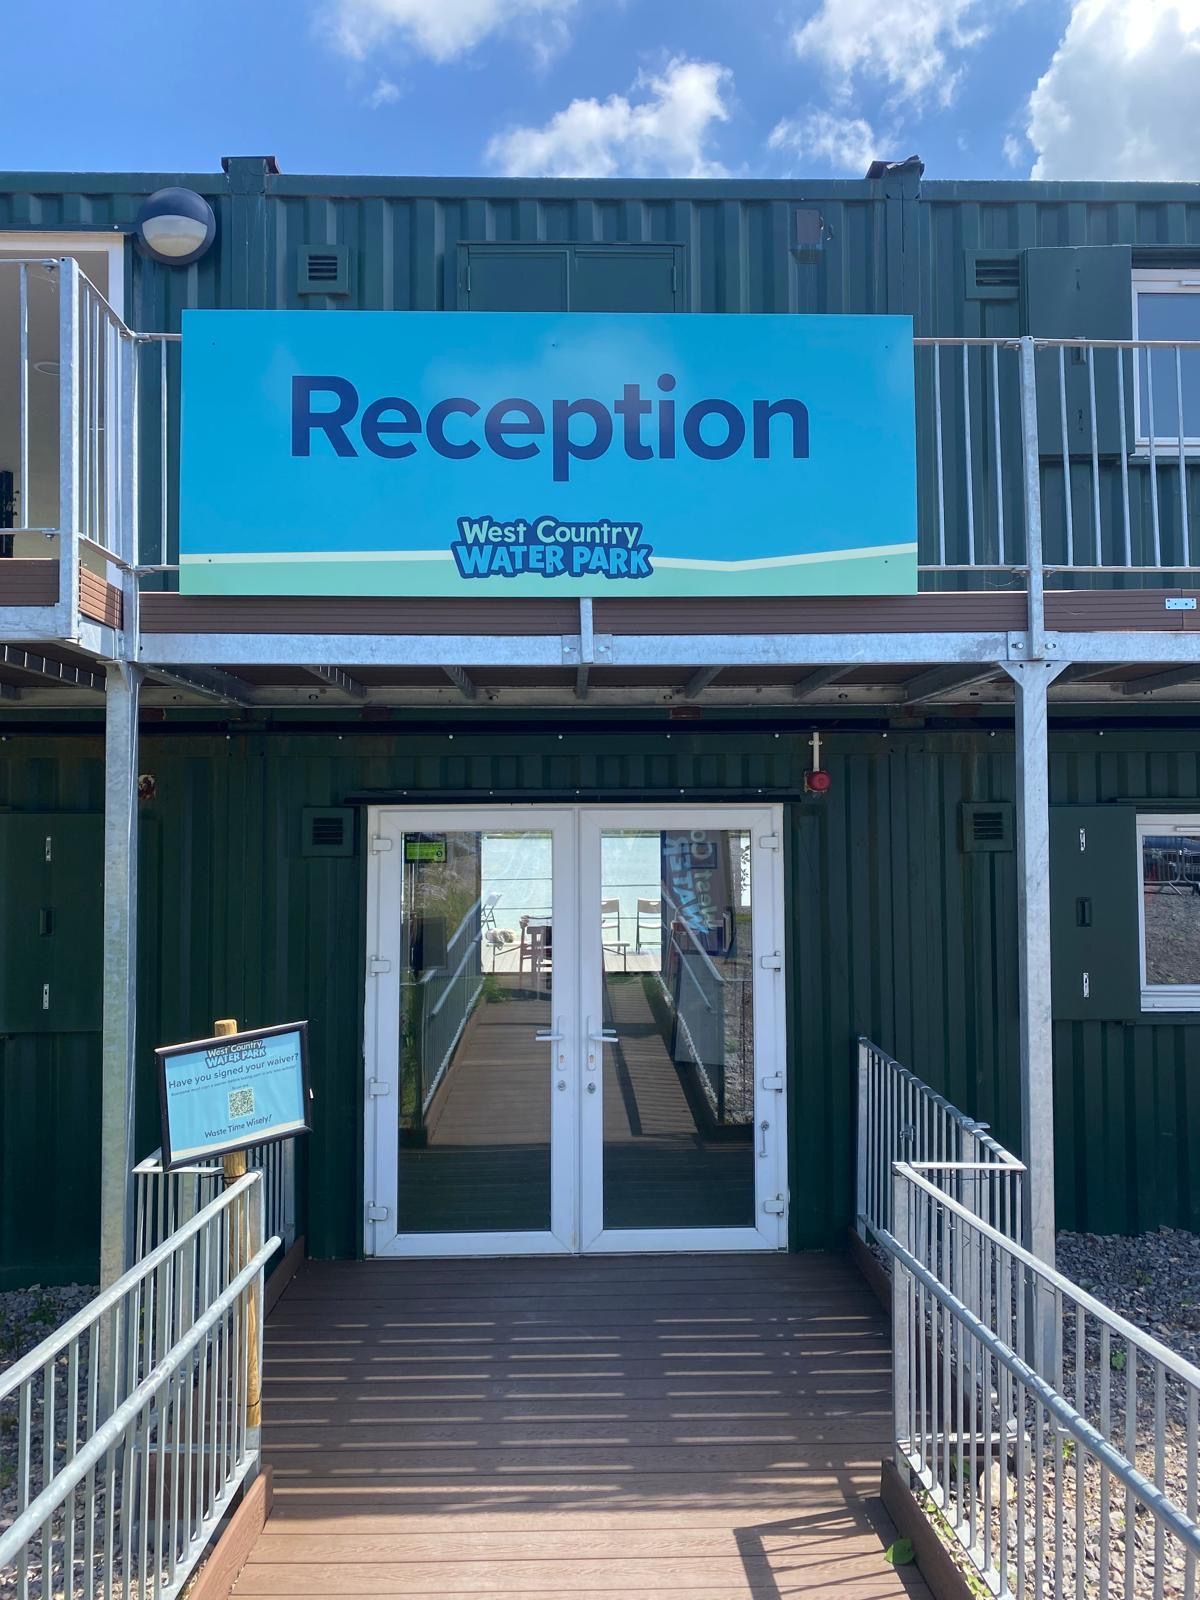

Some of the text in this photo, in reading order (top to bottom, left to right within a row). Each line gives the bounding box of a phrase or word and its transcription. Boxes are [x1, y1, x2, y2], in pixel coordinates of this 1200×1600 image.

[291, 373, 810, 482] Reception
[462, 519, 639, 548] West Country
[456, 544, 650, 575] WATER PARK
[206, 1048, 266, 1068] WATER PARK
[207, 1041, 262, 1058] West Country
[168, 1078, 193, 1089] Have
[195, 1073, 212, 1085] you
[214, 1066, 244, 1079] signed
[245, 1061, 265, 1073] your
[267, 1053, 299, 1067] waiver?
[204, 1113, 272, 1139] Waste Time Wisely!
